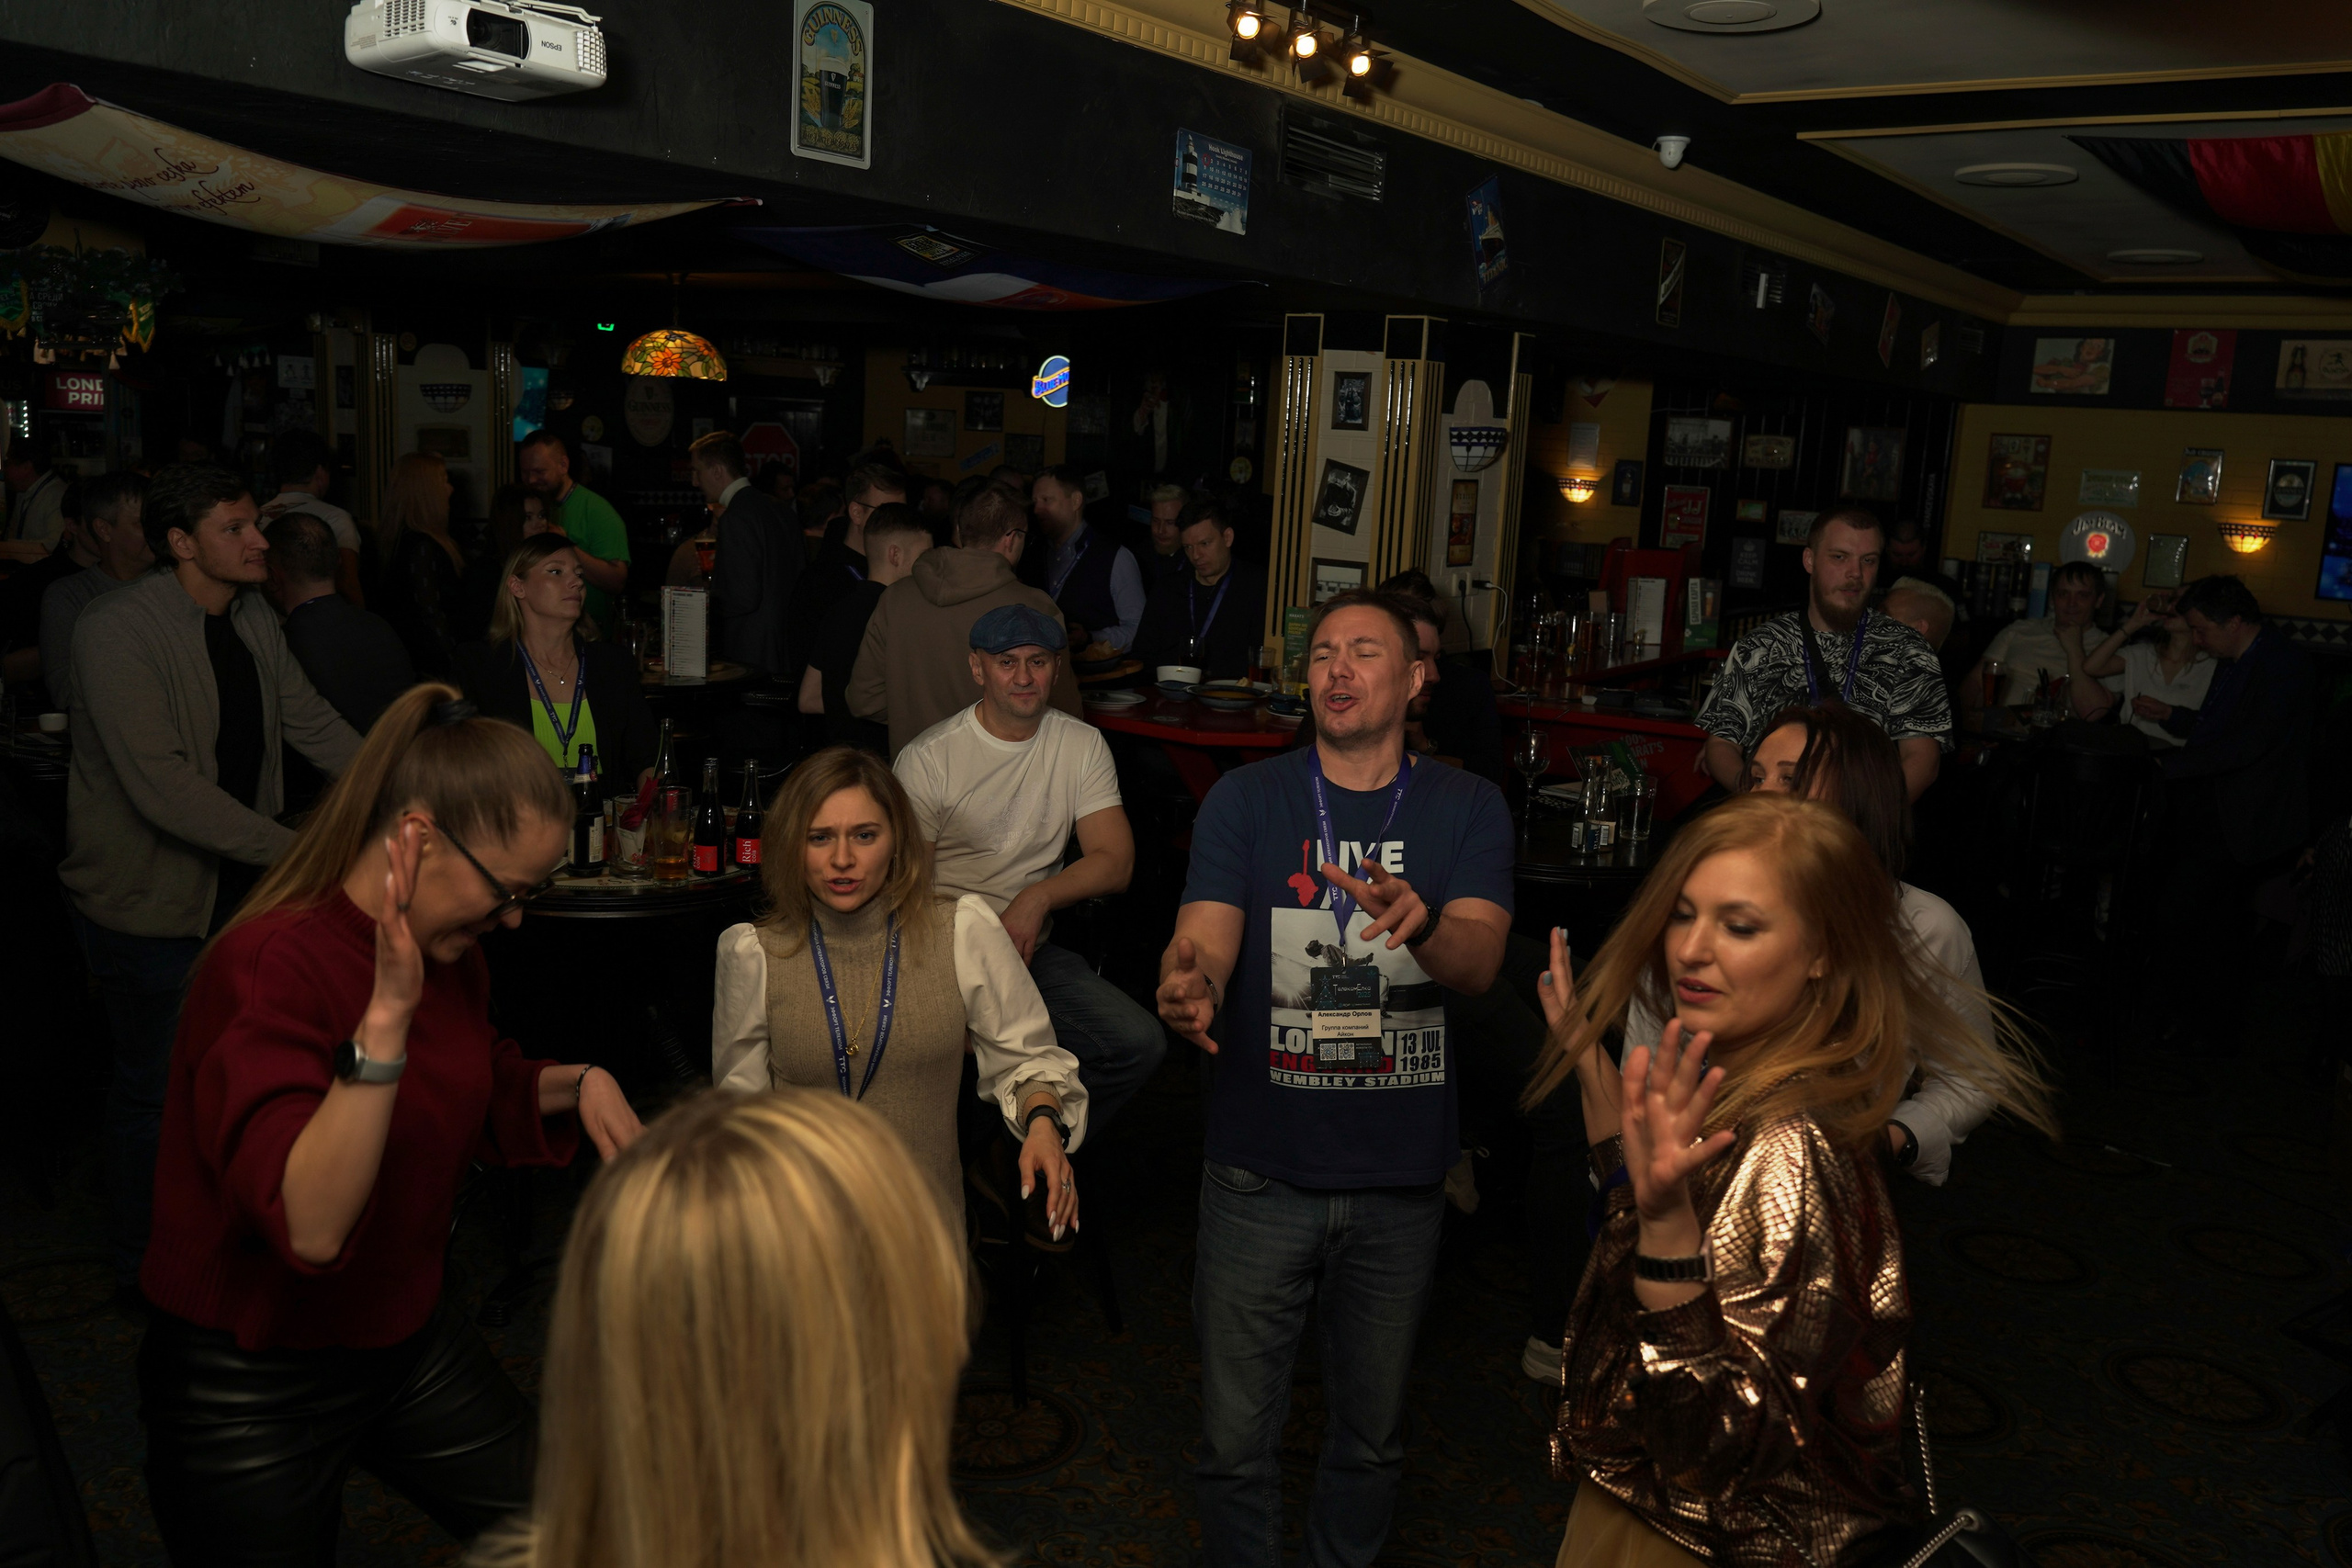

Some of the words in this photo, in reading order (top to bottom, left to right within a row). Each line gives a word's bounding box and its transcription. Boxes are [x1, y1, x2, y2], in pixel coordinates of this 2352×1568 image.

[803, 6, 862, 56] GUINNESS
[540, 40, 562, 51] EPSON
[627, 400, 673, 413] GUINNESS
[2072, 516, 2094, 536] JIM
[2097, 515, 2127, 539] BEAM
[741, 840, 752, 863] Rich
[816, 945, 828, 976] ОПЕРАТОРОВ
[829, 1006, 838, 1029] ЭФФОРТ
[880, 1014, 888, 1032] СВЯЗИ
[1271, 1025, 1395, 1056] LON
[1401, 1032, 1418, 1055] 13
[1421, 1030, 1441, 1054] JUL
[1400, 1053, 1442, 1071] 1985
[1271, 1070, 1356, 1087] WEMBLEY
[1363, 1071, 1445, 1087] STADIUM
